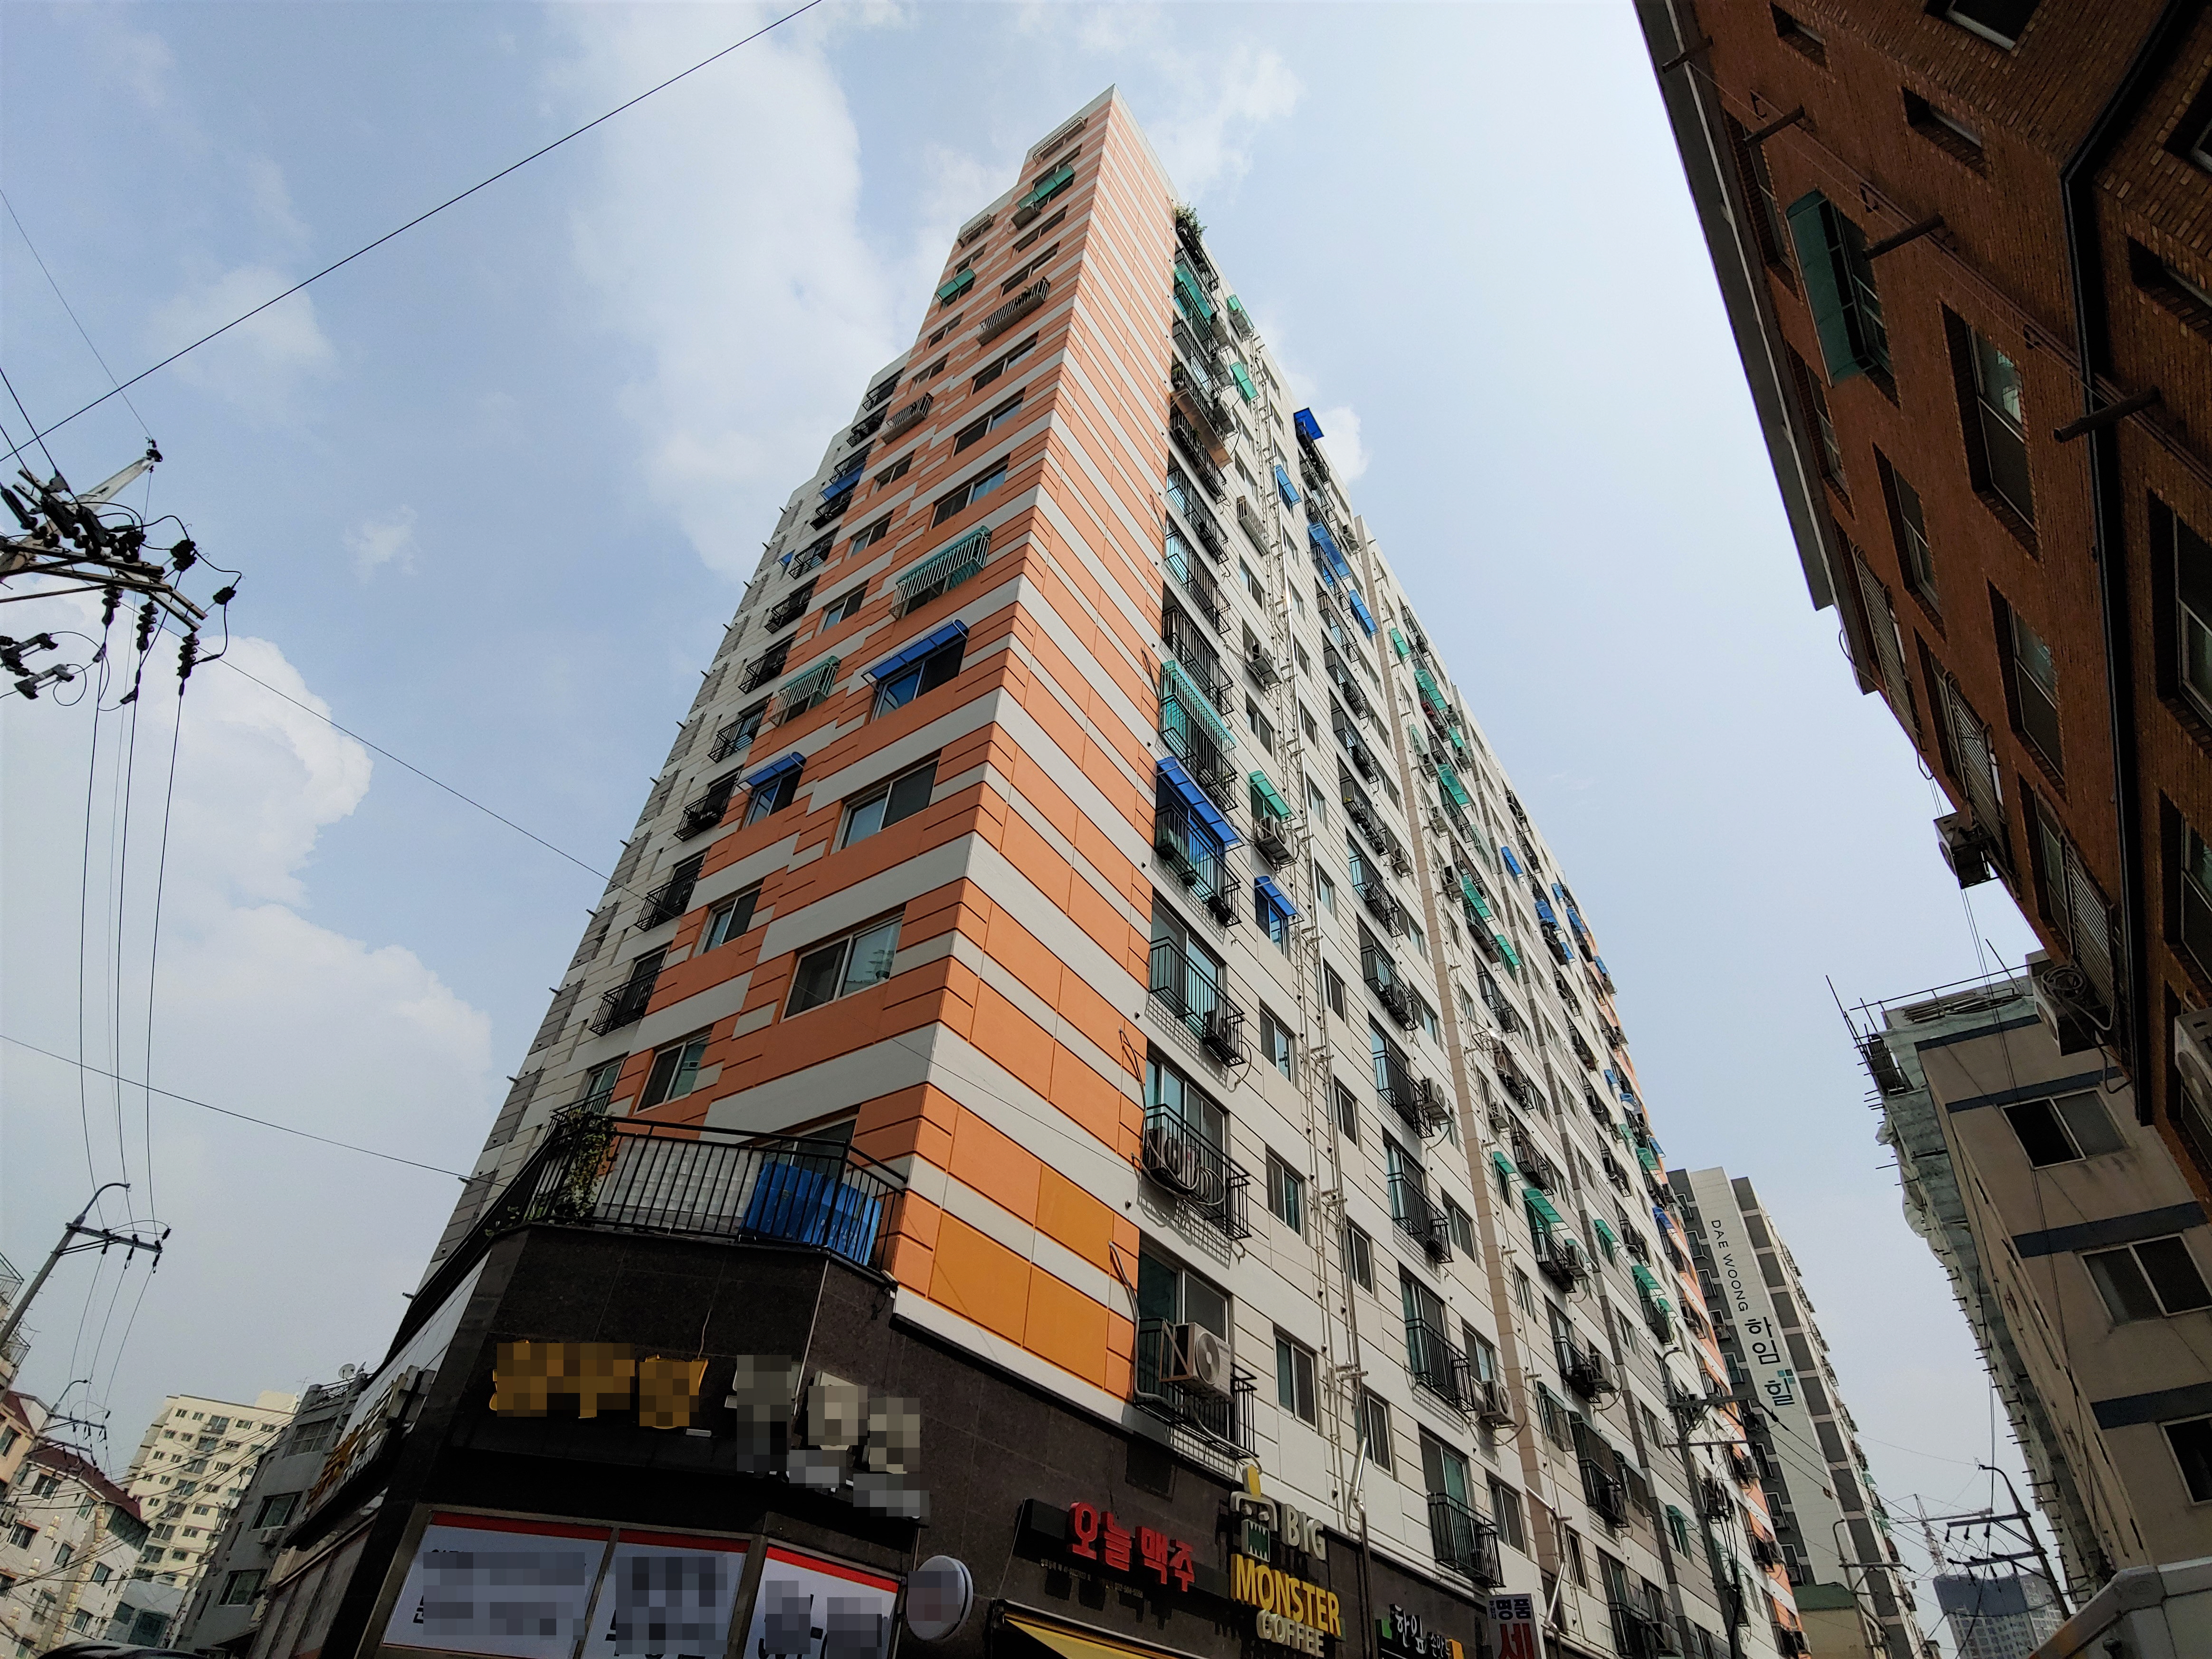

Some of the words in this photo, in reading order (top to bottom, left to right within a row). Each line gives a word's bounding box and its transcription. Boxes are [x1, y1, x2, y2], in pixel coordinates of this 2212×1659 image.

[1711, 1220, 1728, 1249] DAE
[1723, 1253, 1749, 1312] WOONG
[1070, 1502, 1132, 1572] 오늘
[1136, 1526, 1195, 1592] 맥주
[1282, 1504, 1326, 1560] BIG
[1231, 1554, 1341, 1636] MONSTER
[1496, 1598, 1531, 1621] 명품
[1257, 1610, 1325, 1658] COFFEE
[1498, 1623, 1535, 1659] 세
